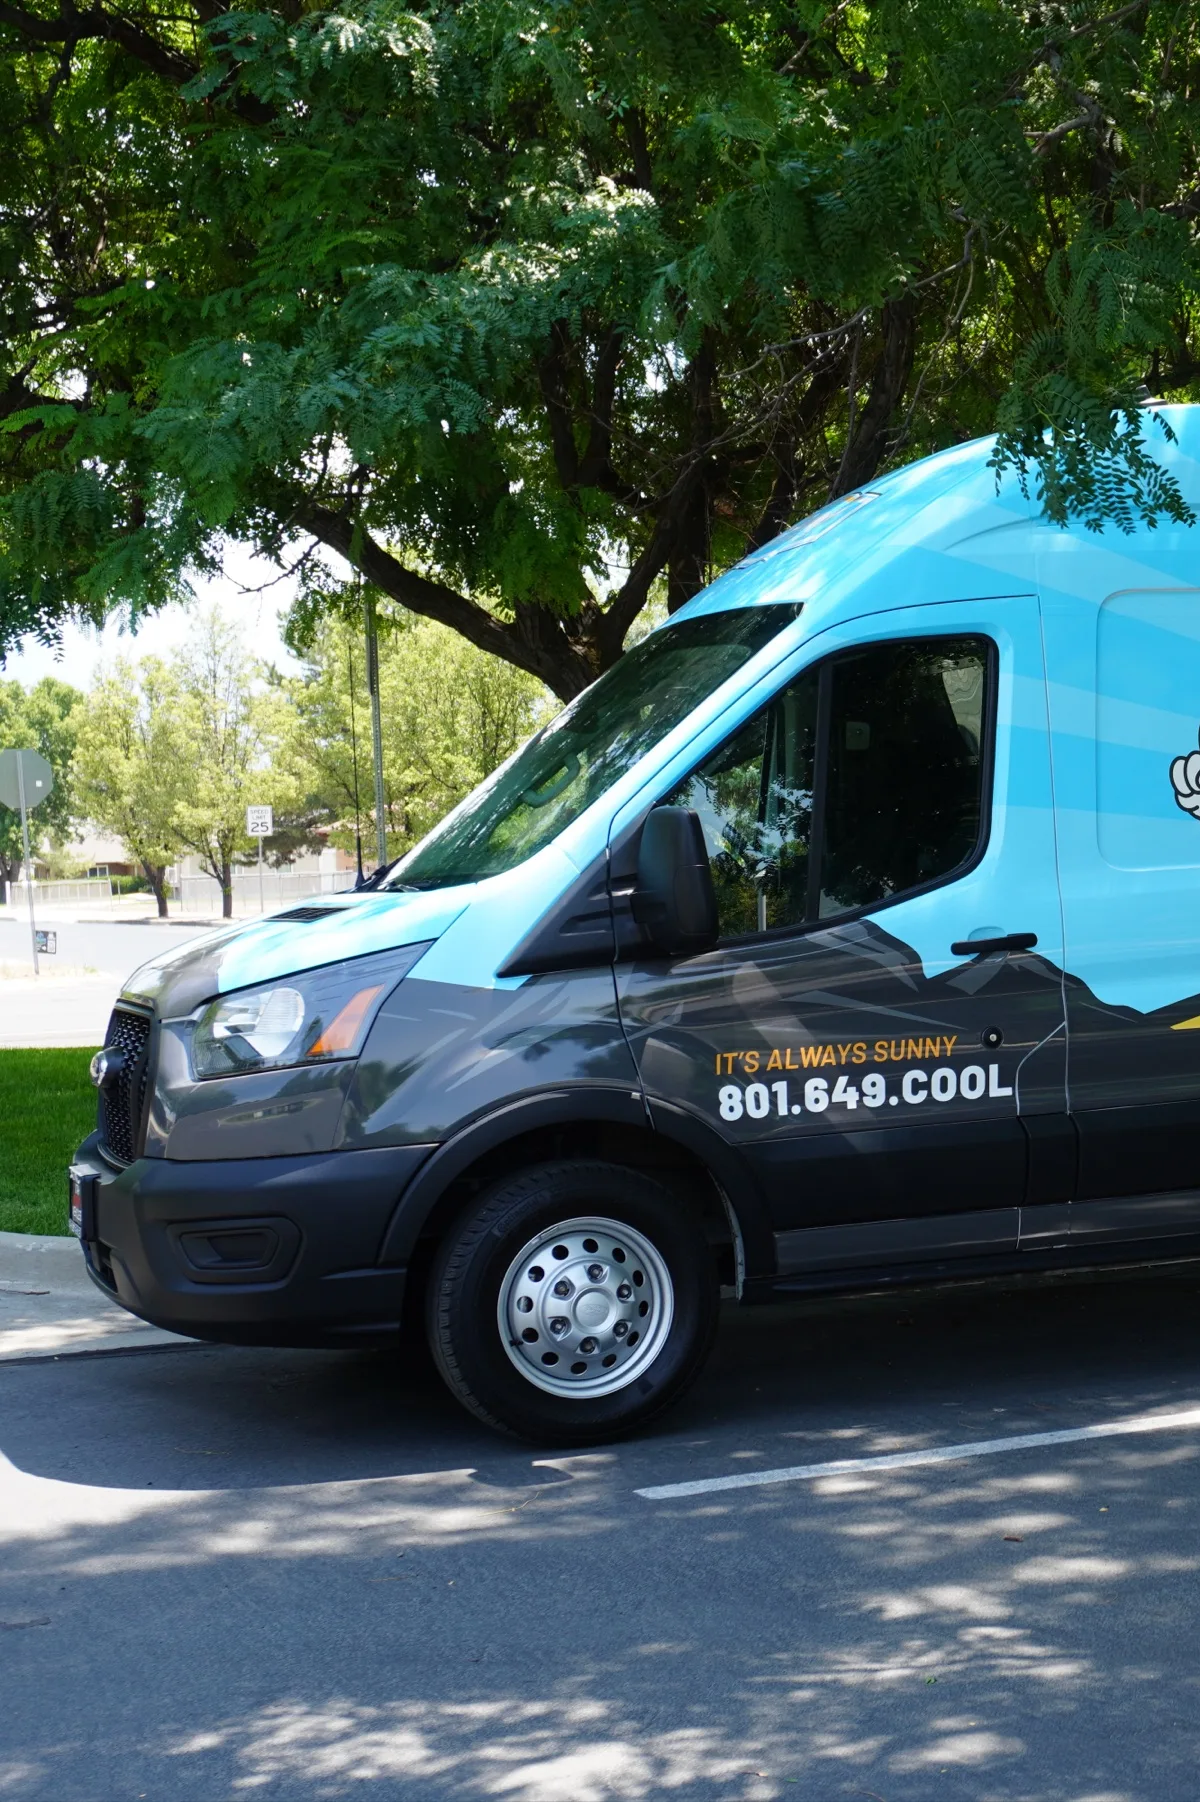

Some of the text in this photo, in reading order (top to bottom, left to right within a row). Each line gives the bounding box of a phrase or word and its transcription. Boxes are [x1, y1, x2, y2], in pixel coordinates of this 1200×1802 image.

[251, 821, 269, 833] 25
[715, 1036, 957, 1076] IT'S ALWAYS SUNNY
[718, 1063, 1013, 1122] 801.649.COOL
